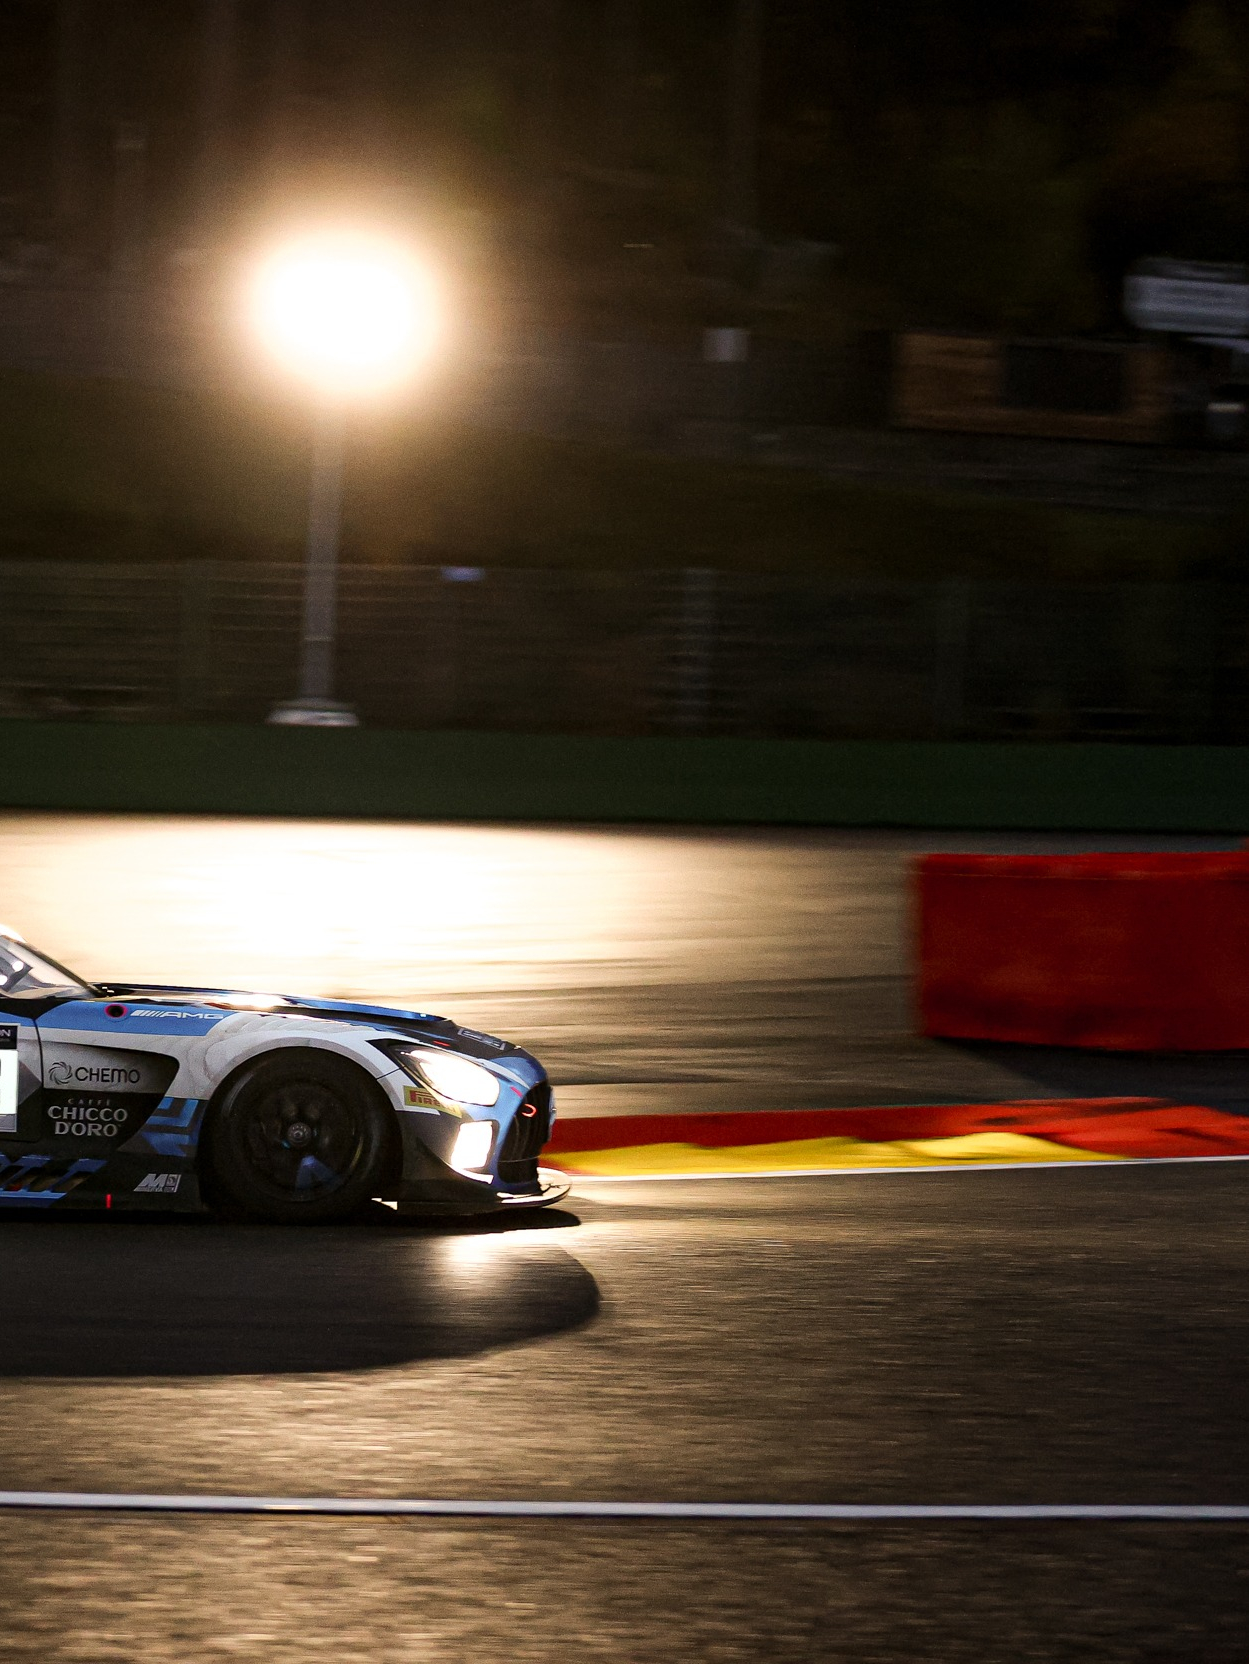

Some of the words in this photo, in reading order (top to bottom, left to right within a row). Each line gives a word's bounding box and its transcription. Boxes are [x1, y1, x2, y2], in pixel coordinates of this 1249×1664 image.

[160, 1011, 224, 1020] AMG
[75, 1067, 140, 1084] CHEMO
[47, 1105, 129, 1122] CHICCO
